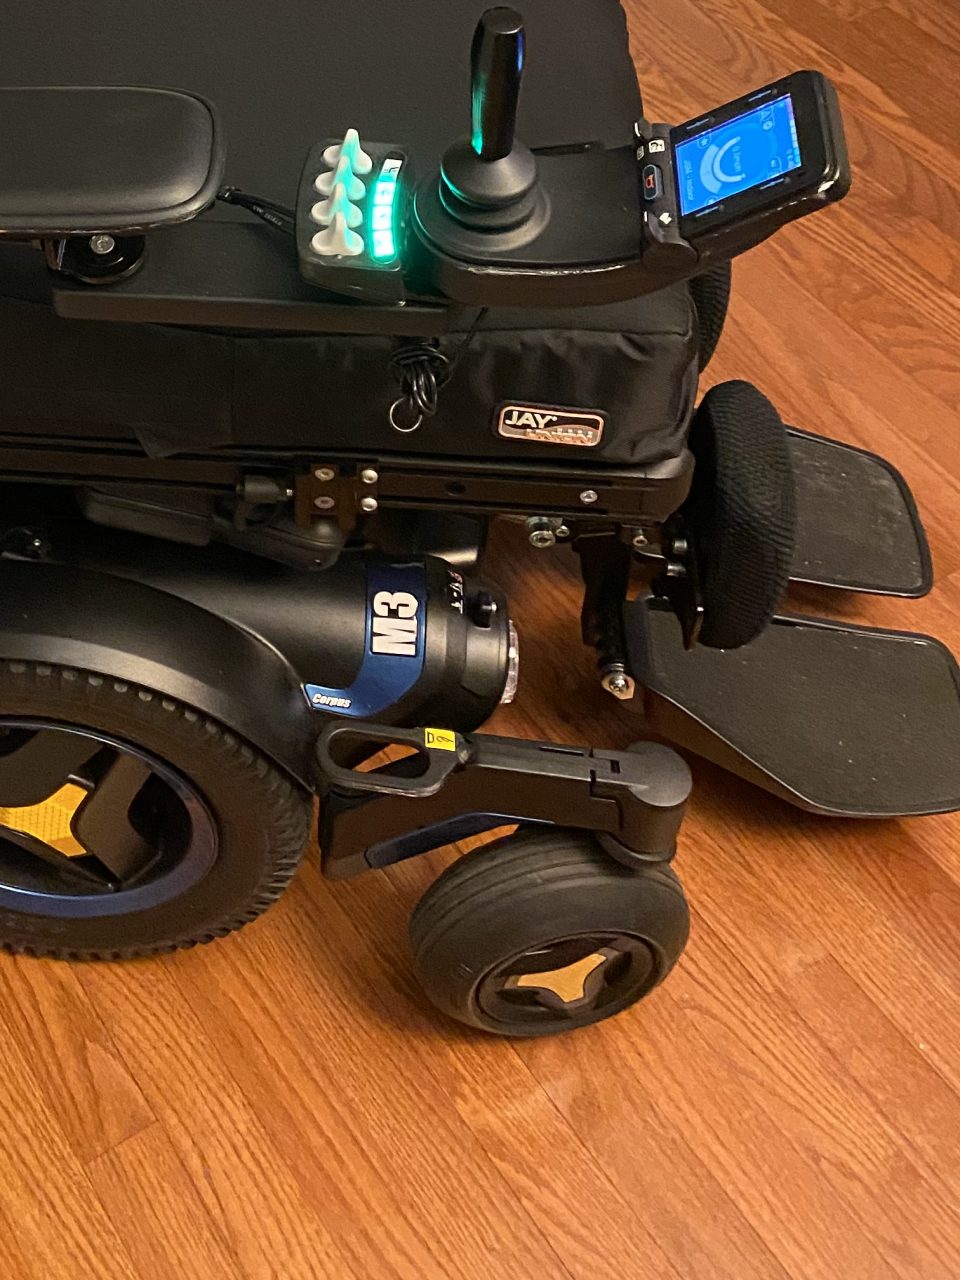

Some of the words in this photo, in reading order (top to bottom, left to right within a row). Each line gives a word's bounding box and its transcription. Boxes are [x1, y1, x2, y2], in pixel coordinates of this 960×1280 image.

[505, 410, 553, 429] JAY
[371, 589, 419, 656] M3
[312, 693, 352, 708] Corpus
